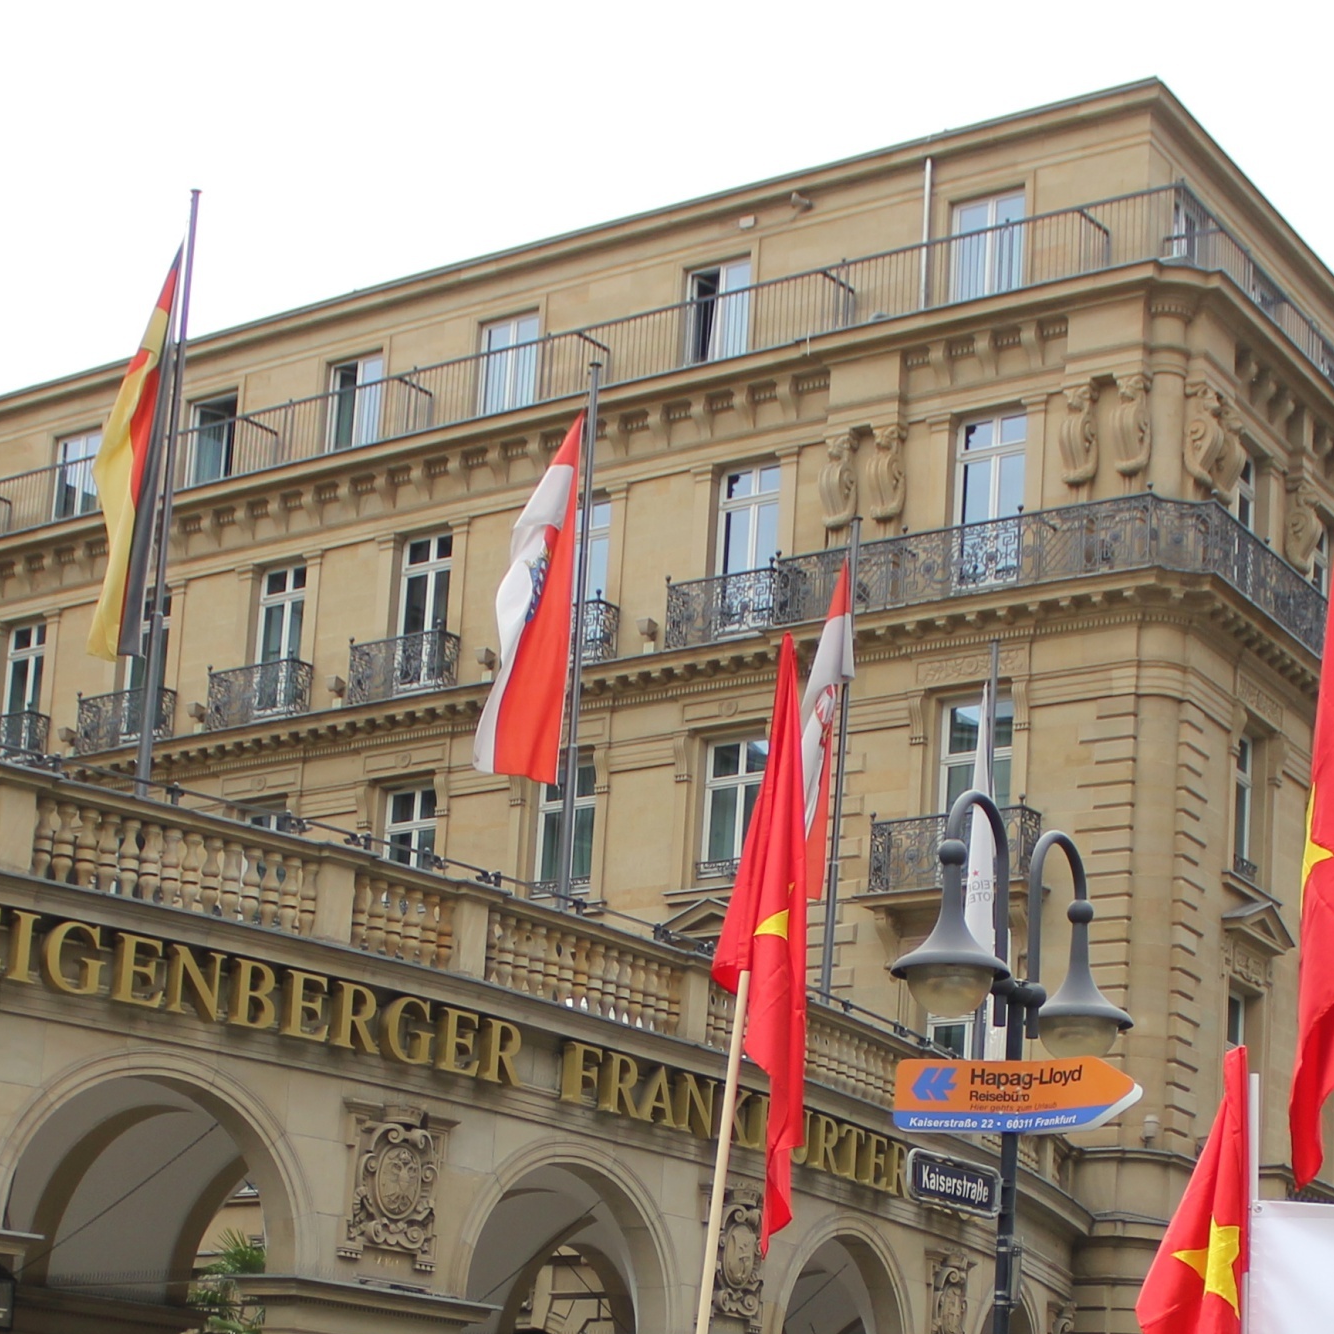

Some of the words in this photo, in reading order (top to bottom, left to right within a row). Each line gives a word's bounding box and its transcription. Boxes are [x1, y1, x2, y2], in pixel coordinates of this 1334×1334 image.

[970, 1065, 1083, 1090] Hapag-Lloyd
[969, 1090, 1030, 1102] Reisebüro
[909, 1117, 978, 1128] Kaiserstraße
[981, 1118, 994, 1129] 22
[1006, 1119, 1033, 1129] 60311
[1035, 1115, 1077, 1127] Frankfurt
[922, 1165, 989, 1204] Kaiserstraße
